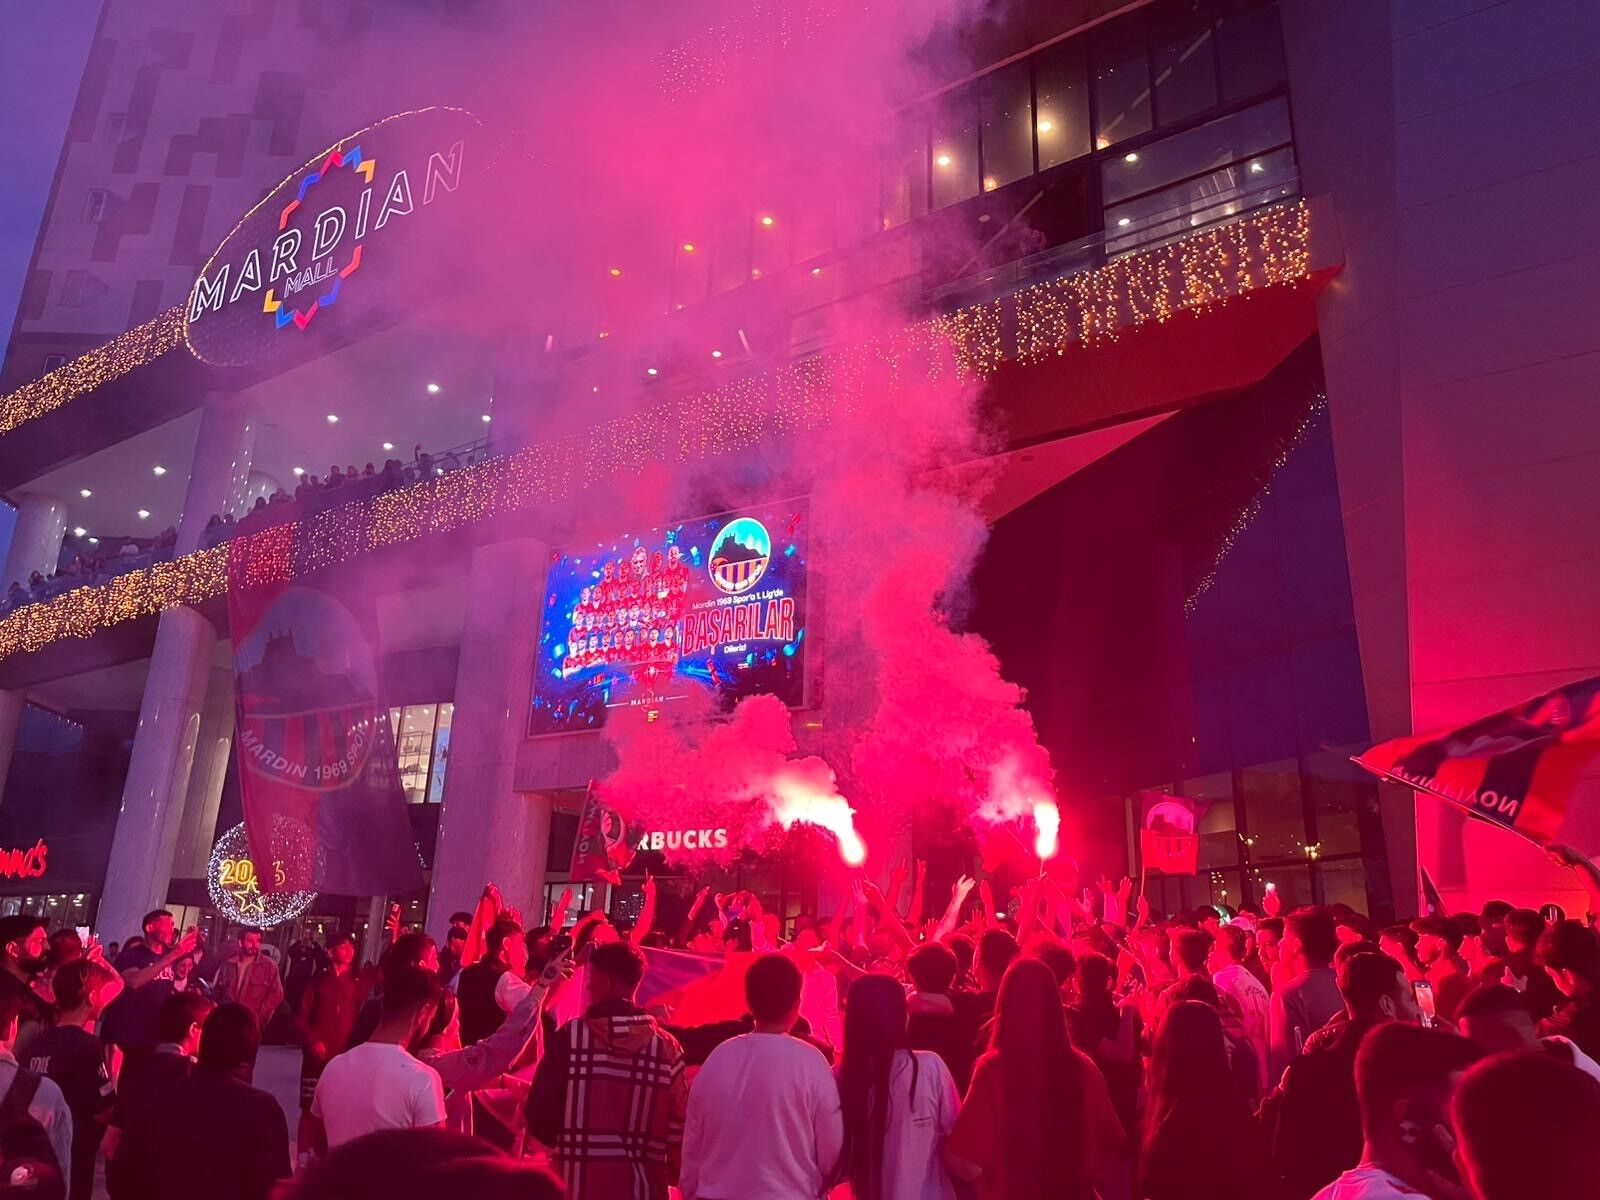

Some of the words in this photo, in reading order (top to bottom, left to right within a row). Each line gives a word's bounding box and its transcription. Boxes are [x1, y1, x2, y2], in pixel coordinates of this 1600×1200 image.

[189, 139, 465, 323] MARDIAN
[283, 256, 338, 299] MALL
[682, 597, 795, 657] BAŞARILAR
[314, 759, 348, 781] 1969
